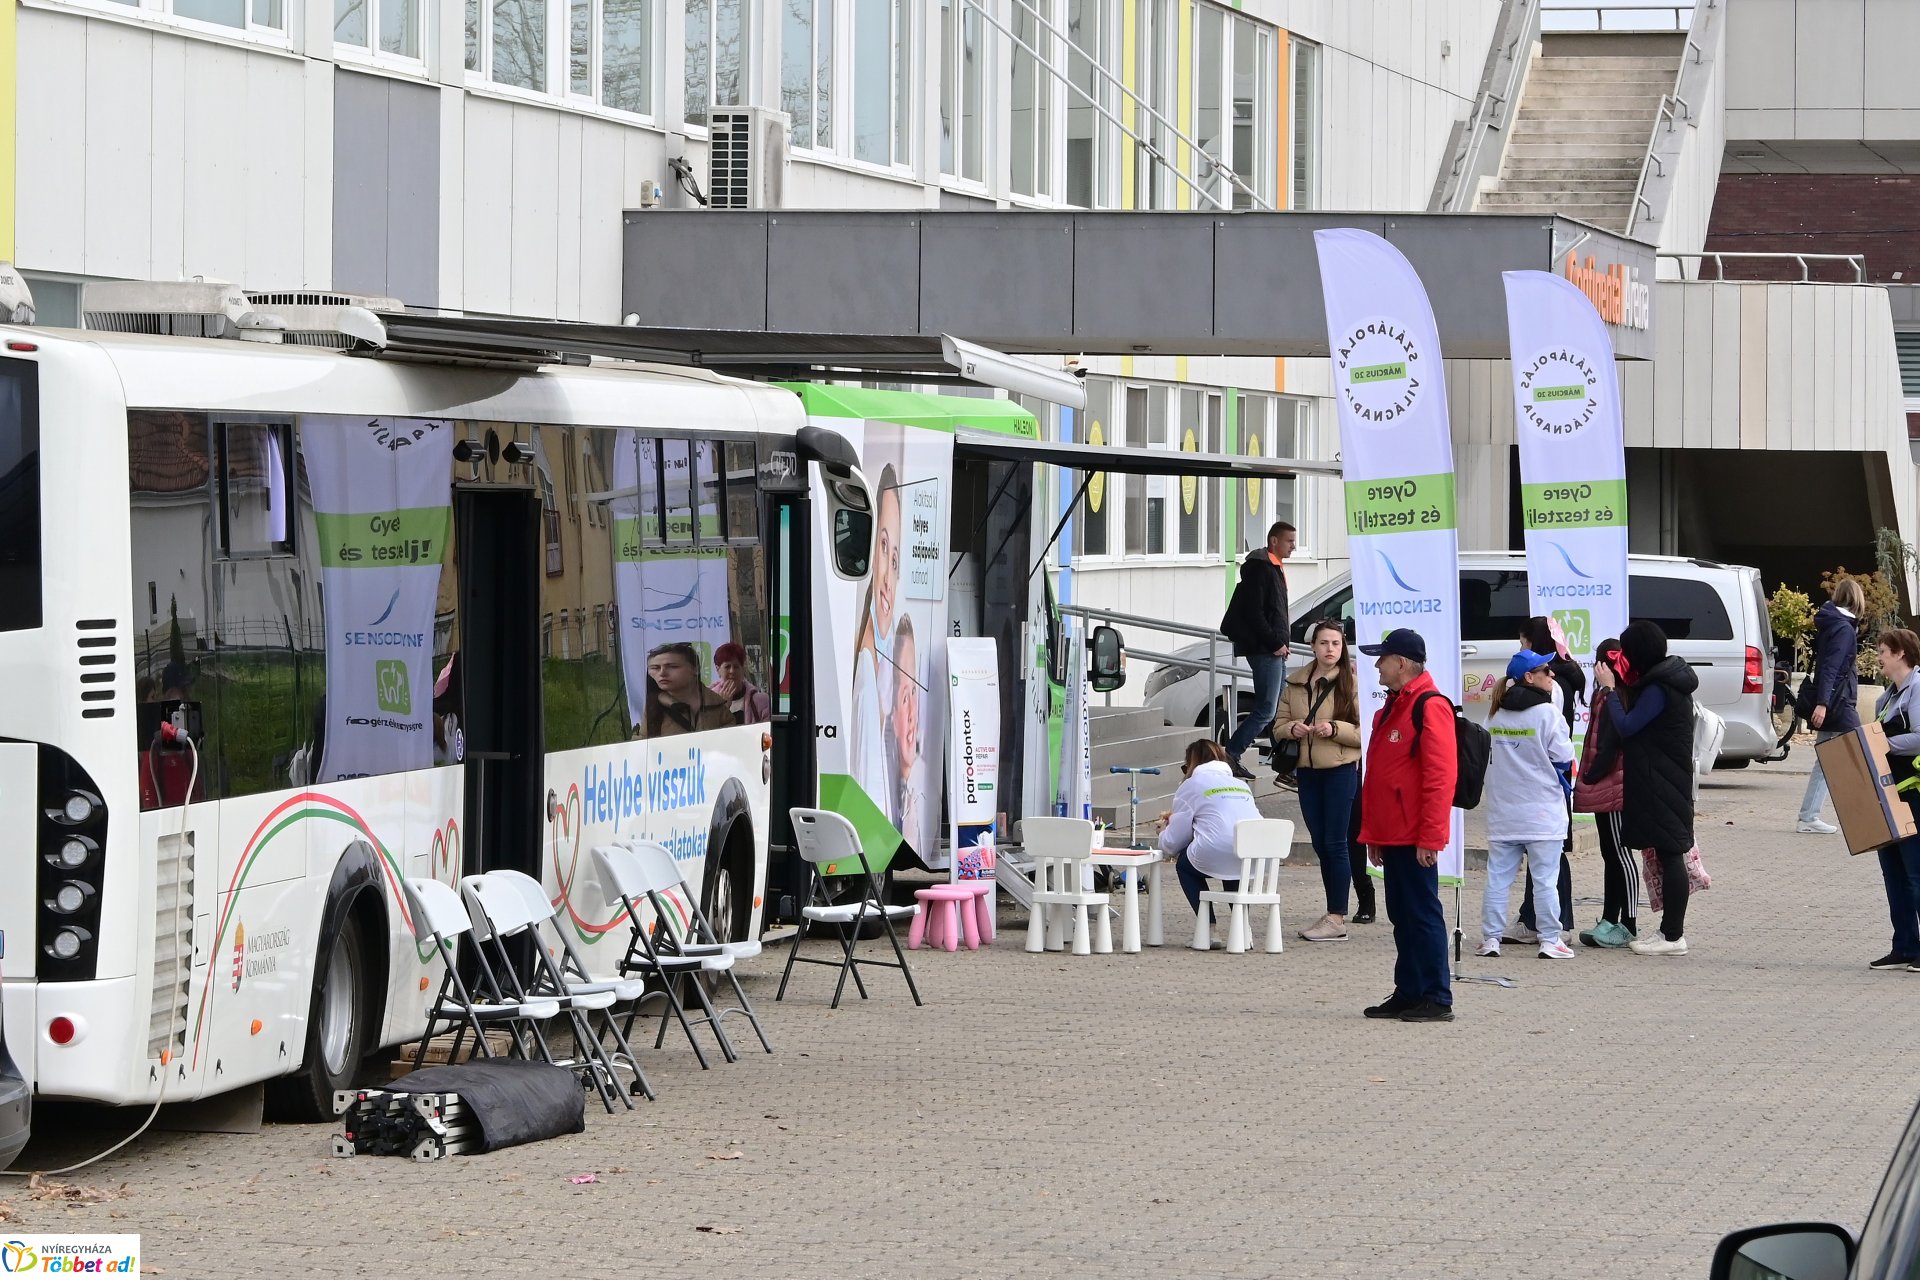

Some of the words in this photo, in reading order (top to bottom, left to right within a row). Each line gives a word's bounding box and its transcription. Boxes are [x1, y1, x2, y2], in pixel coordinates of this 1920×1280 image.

[583, 759, 643, 834] Helybe
[648, 747, 705, 813] visszük
[963, 710, 977, 804] parodontax
